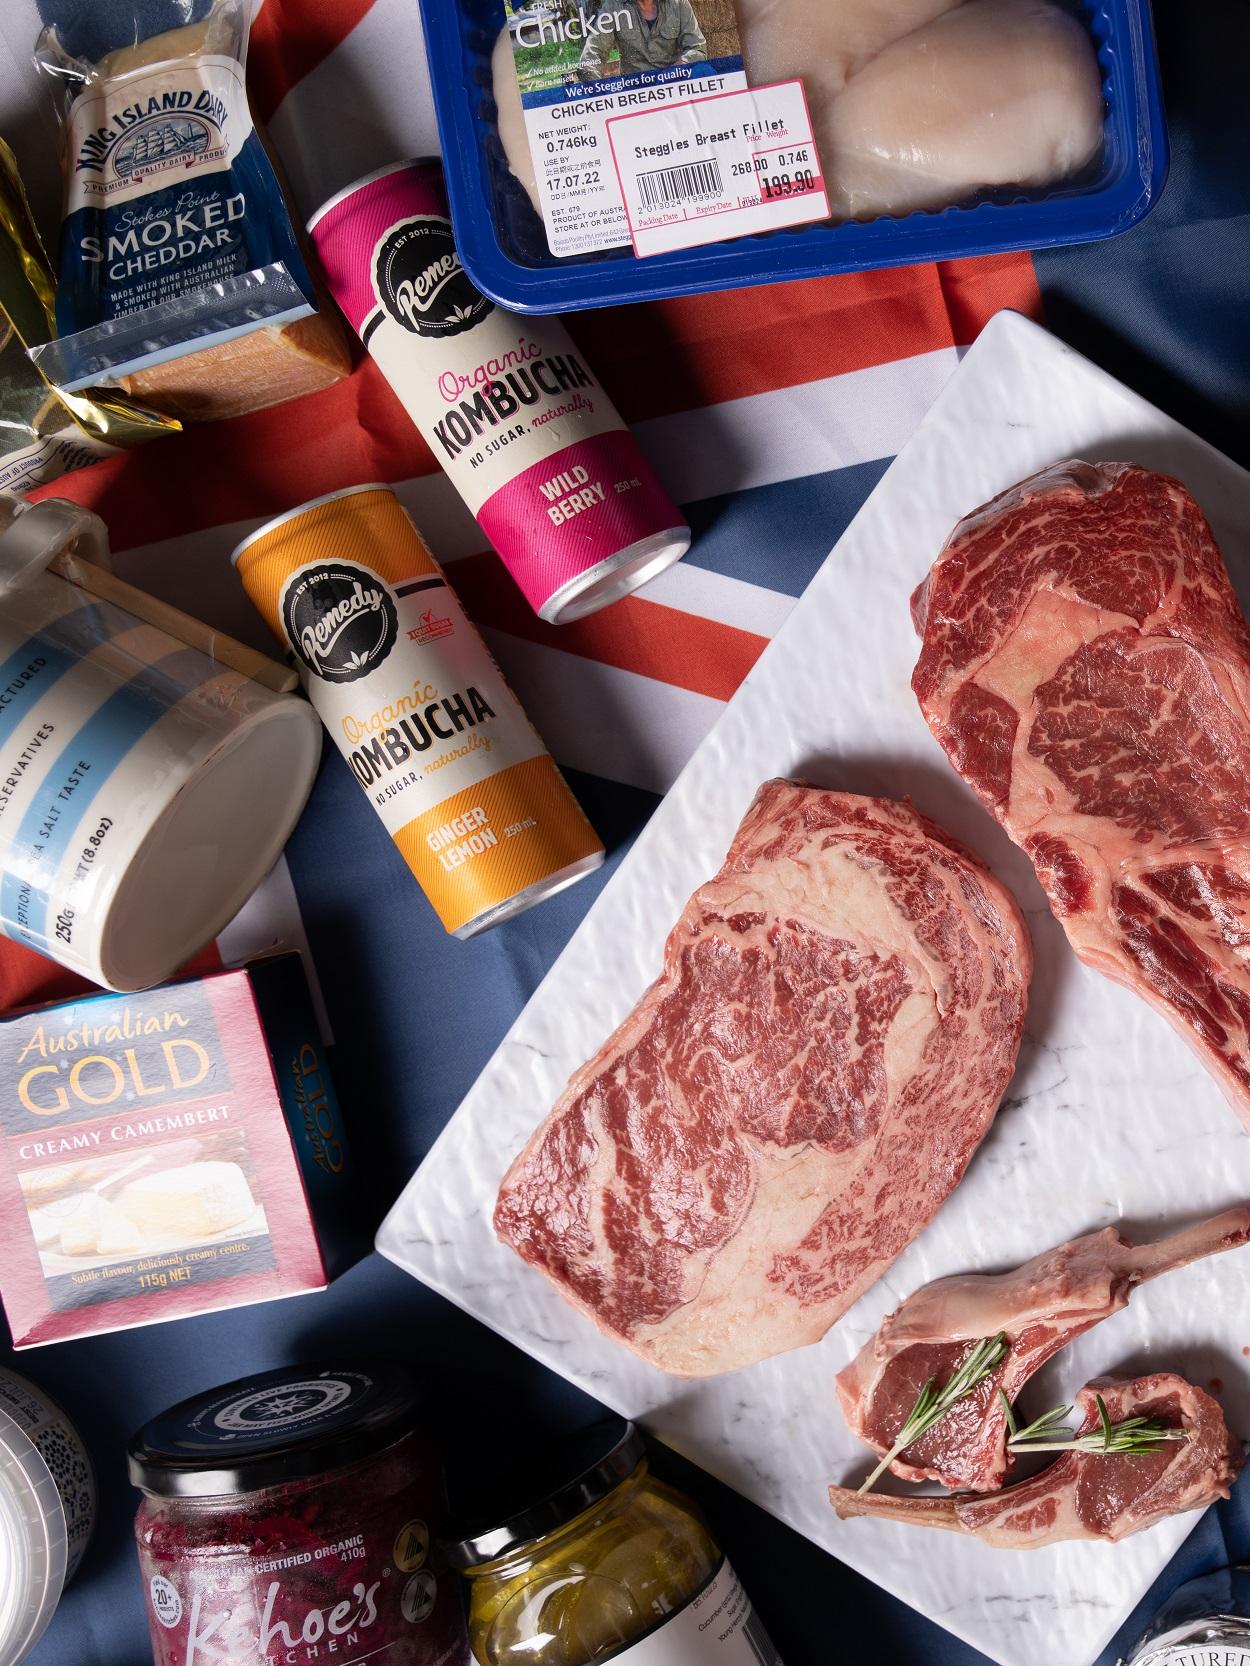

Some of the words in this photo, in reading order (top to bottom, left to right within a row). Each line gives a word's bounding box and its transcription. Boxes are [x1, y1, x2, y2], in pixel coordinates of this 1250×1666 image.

[516, 7, 633, 48] Chicken
[552, 98, 613, 119] CHICKEN
[618, 88, 674, 109] BREAST
[679, 78, 725, 96] FILLET
[566, 86, 592, 97] We're
[595, 76, 639, 93] Stegglers
[641, 75, 654, 87] for
[657, 66, 692, 85] quality
[76, 128, 117, 172] KING
[113, 92, 192, 128] ISLAND
[194, 90, 228, 127] DAIRY
[539, 131, 554, 139] NET
[556, 124, 590, 136] WEIGHT:
[547, 136, 597, 153] 0.746kg
[635, 139, 689, 158] Steggles
[696, 129, 736, 147] Breast
[743, 119, 784, 136] Fillet
[547, 171, 600, 191] 17.07.22
[732, 158, 768, 176] 268.00
[778, 150, 808, 166] 0.746
[762, 169, 815, 199] 199.90
[81, 193, 245, 262] SMOKED
[115, 208, 172, 231] Stokes
[176, 191, 219, 212] Point
[109, 229, 233, 280] CHEDDAR
[111, 289, 133, 301] MADE
[137, 280, 157, 295] WITH
[161, 273, 179, 284] KING
[184, 262, 213, 277] ISLAND
[217, 254, 237, 266] MILK
[437, 337, 542, 404] Organic
[432, 352, 592, 460] KOMBUCHA
[539, 464, 589, 502] WILD
[546, 486, 607, 527] BERRY
[302, 581, 383, 672] Remedy
[342, 680, 438, 744] Organic
[376, 793, 384, 806] NO
[385, 771, 423, 799] SUGAR,
[424, 734, 491, 774] naturally
[40, 805, 62, 840] SALT
[58, 760, 90, 803] TASTE
[426, 806, 488, 851] GINGER
[437, 827, 499, 872] LEMON
[17, 1008, 190, 1064] Australian
[18, 1038, 210, 1116] GOLD
[19, 1130, 102, 1160] CREAMY
[111, 1105, 231, 1141] CAMEMBERT
[139, 1271, 168, 1289] 115g
[169, 1266, 192, 1283] NET
[257, 1553, 312, 1575] CERTIFIED
[315, 1534, 364, 1559] ORGANIC
[340, 1547, 366, 1563] 410g
